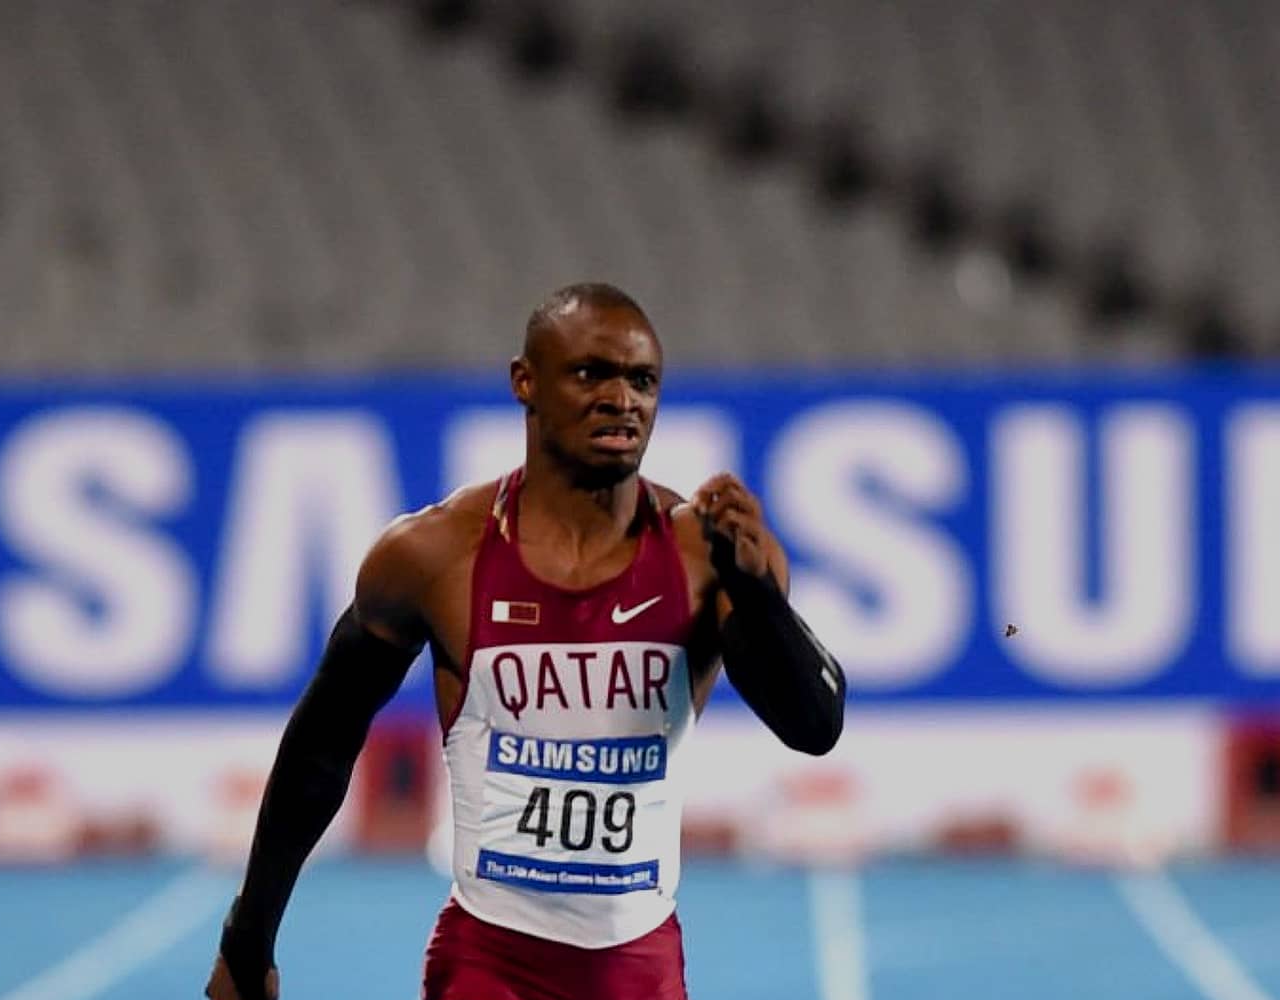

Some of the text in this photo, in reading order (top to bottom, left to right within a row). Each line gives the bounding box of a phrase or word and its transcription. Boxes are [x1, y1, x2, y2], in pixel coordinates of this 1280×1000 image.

[492, 650, 670, 720] QATAR
[498, 736, 660, 774] SAMSUNG
[517, 786, 635, 853] 409
